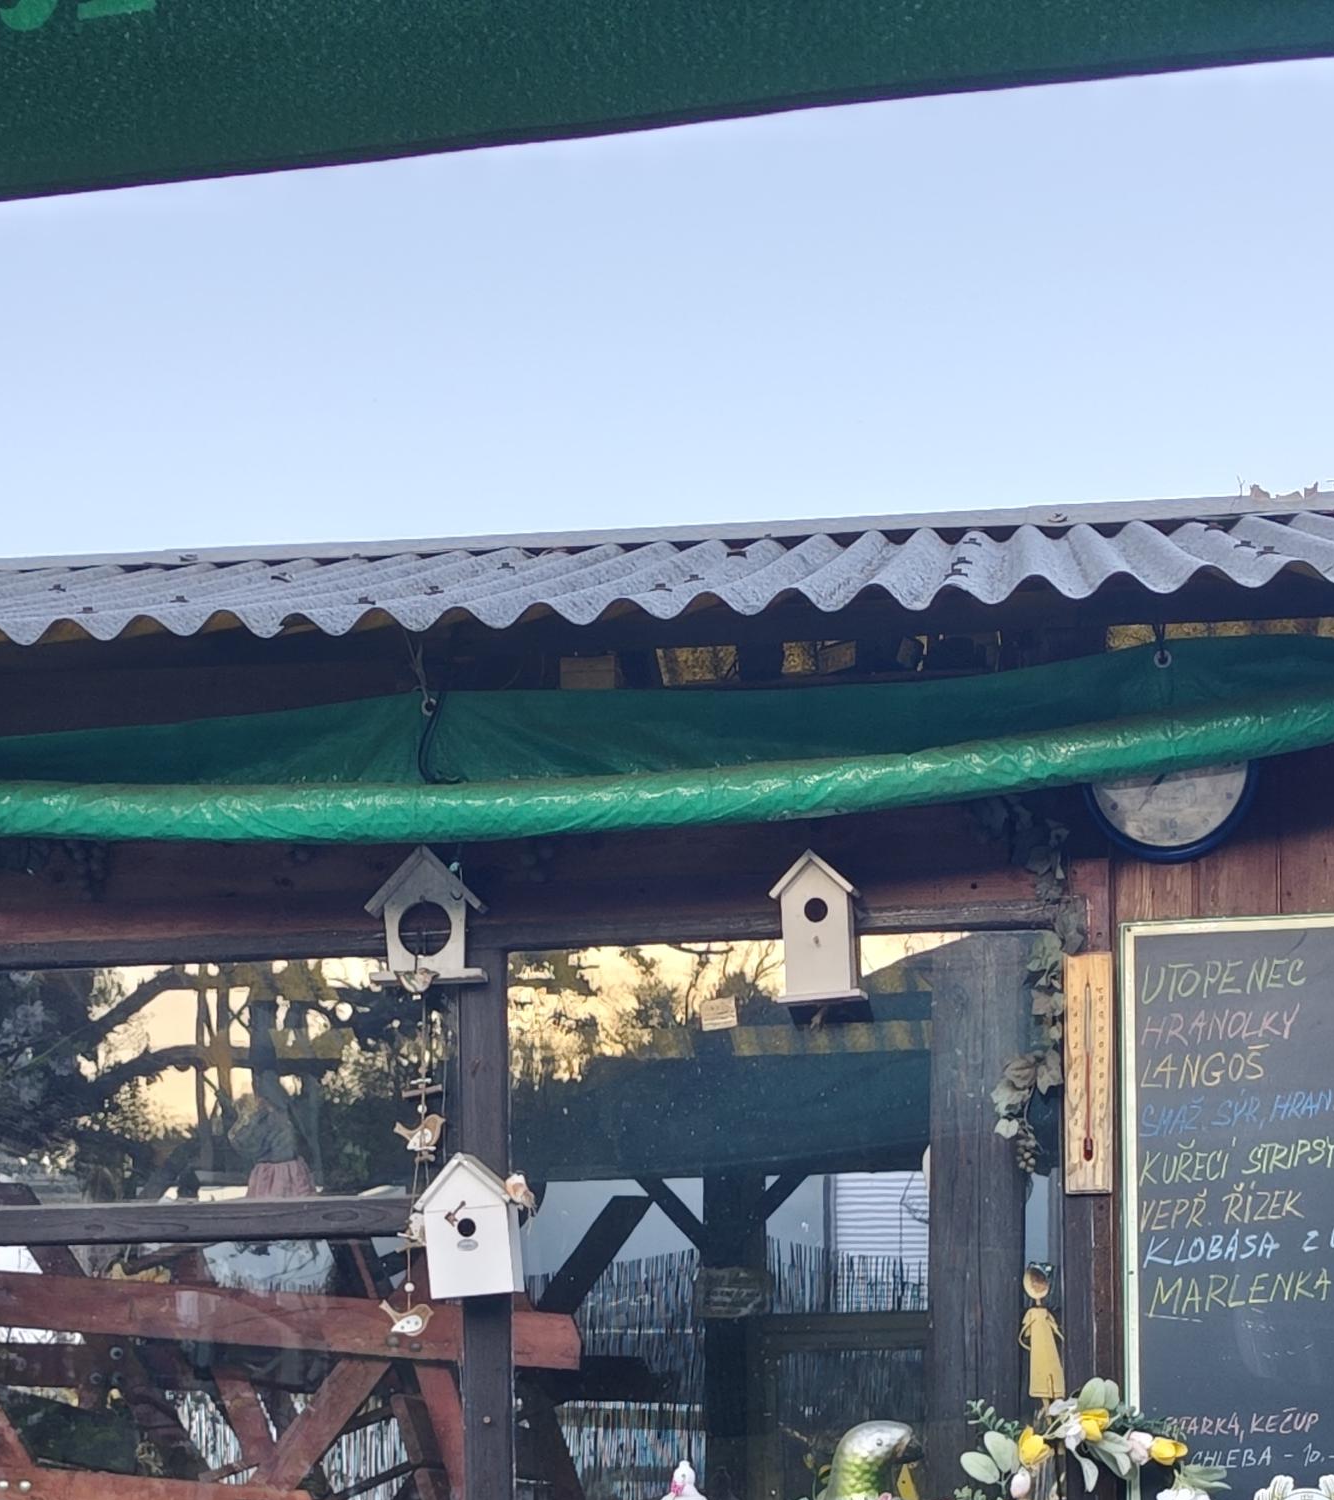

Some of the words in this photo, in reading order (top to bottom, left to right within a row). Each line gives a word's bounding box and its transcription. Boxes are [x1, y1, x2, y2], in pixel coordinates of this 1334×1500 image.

[1141, 958, 1307, 1004] UTOPENEC
[1140, 1003, 1300, 1047] HRANOLKY
[1140, 1043, 1270, 1089] LANGOŠ
[1139, 1138, 1236, 1187] KUŘECÍ
[1222, 1179, 1305, 1224] ŘÍZEK
[1147, 1267, 1332, 1318] MARLENKA
[1250, 1407, 1319, 1434] KEČUP
